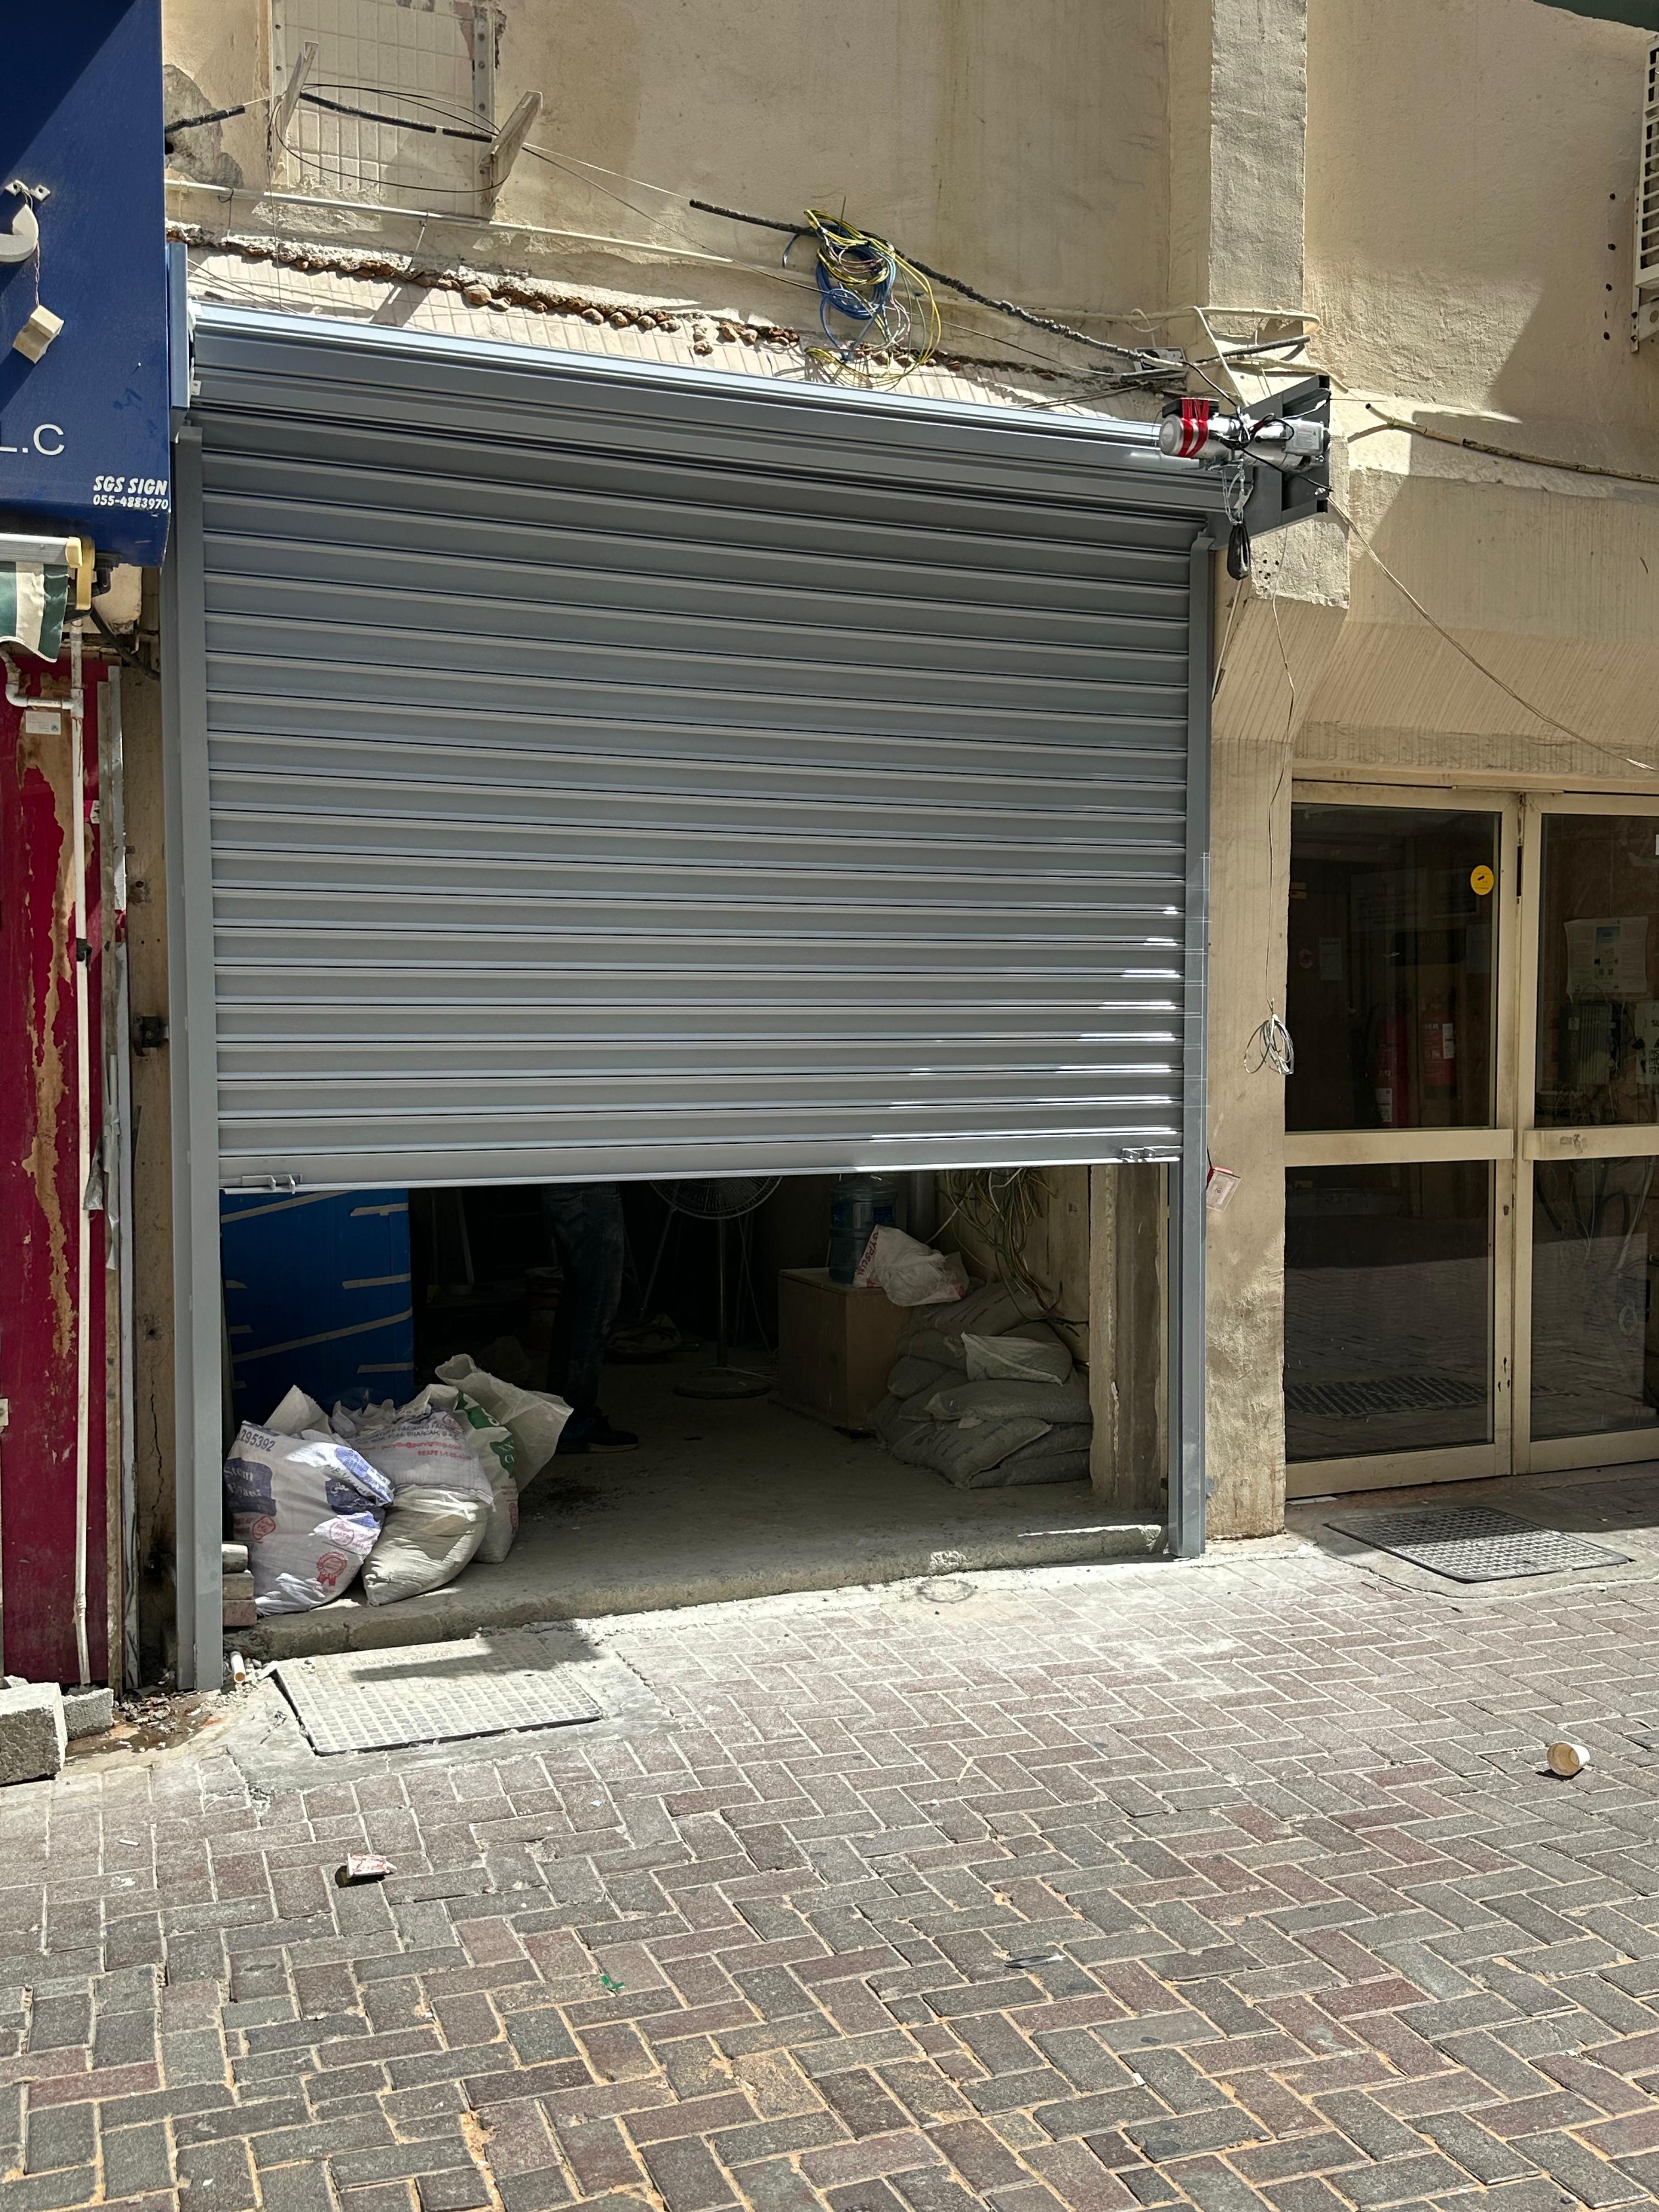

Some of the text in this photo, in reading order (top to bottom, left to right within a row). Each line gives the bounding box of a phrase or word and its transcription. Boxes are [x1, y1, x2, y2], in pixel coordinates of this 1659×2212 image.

[93, 475, 168, 495] SGS SIGN
[92, 494, 169, 510] 055-4883970
